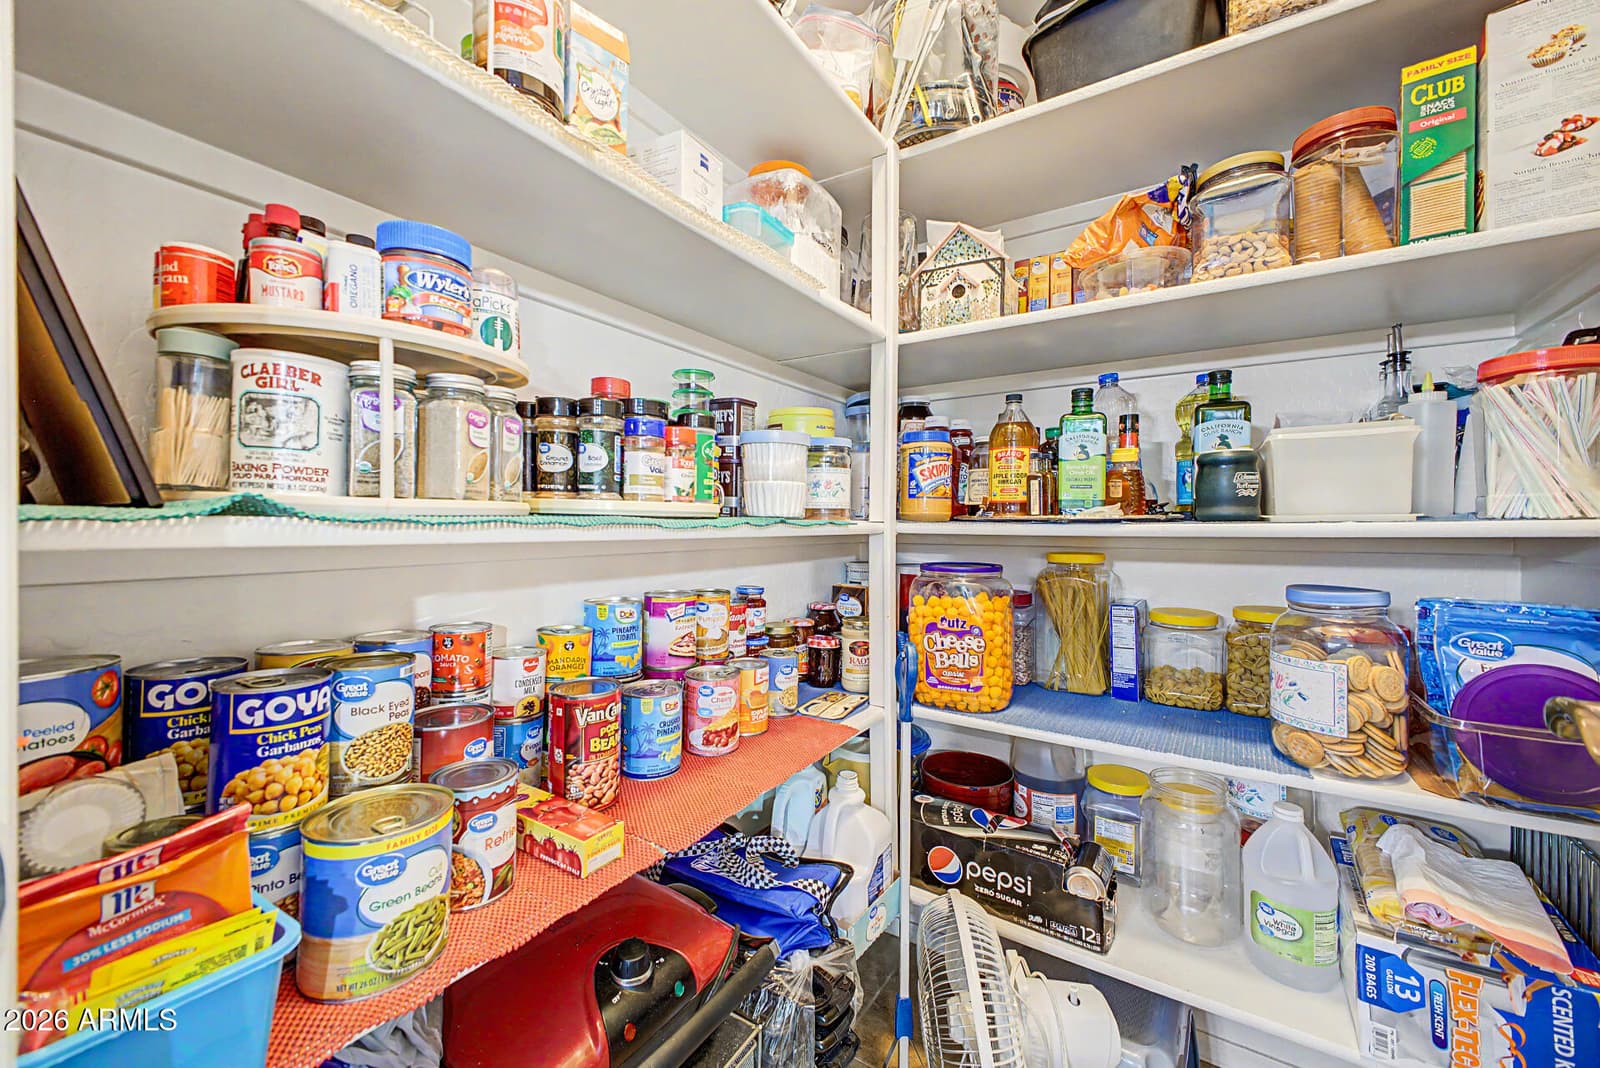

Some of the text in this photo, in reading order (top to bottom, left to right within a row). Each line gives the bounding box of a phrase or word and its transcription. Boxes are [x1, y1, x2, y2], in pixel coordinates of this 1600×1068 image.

[1406, 54, 1472, 82] FAMILY SIZE
[581, 81, 611, 98] Crystal
[1410, 74, 1466, 107] CLUB
[1420, 97, 1455, 112] SNACK
[1420, 114, 1456, 129] Original
[161, 261, 178, 272] nd
[261, 284, 304, 302] MUSTARD
[350, 263, 359, 309] OREGANO
[240, 362, 323, 388] CLABBER
[255, 376, 302, 392] GIRL
[714, 409, 735, 422] HEY'S
[1200, 422, 1245, 434] CALIFORNIA
[254, 473, 277, 482] PARA
[272, 463, 329, 478] POWDER
[612, 626, 642, 637] PINEAPPLE
[924, 630, 986, 655] Cheese
[1457, 637, 1505, 655] Great
[849, 657, 868, 668] RAO
[934, 654, 980, 670] Balls
[1467, 649, 1504, 662] Value
[147, 681, 209, 711] GO
[336, 683, 369, 694] Great
[524, 685, 536, 695] MILK
[236, 685, 331, 728] GOYA
[350, 699, 410, 717] Black Eyed
[23, 720, 76, 737] Peeled
[167, 714, 208, 729] Chick
[167, 724, 210, 741] Garba
[256, 722, 324, 747] Chick Peas
[24, 734, 76, 752] atoes
[386, 833, 422, 852] FAMILY
[485, 825, 517, 852] Refri
[361, 859, 401, 881] Great
[970, 861, 1036, 897] pepsi
[369, 874, 444, 913] Green Beans
[974, 883, 1024, 908] ZERO SUGAR
[88, 896, 167, 939] McCormick
[1273, 917, 1297, 932] White
[1080, 926, 1097, 945] 12
[1263, 920, 1297, 937] Vinegar
[72, 911, 186, 969] 30% LESS SODIUM
[1364, 953, 1377, 1000] 200 BAGS
[1393, 975, 1421, 1003] 13
[1432, 990, 1445, 1041] FRESH SCENT
[1551, 986, 1576, 1058] SCENTED
